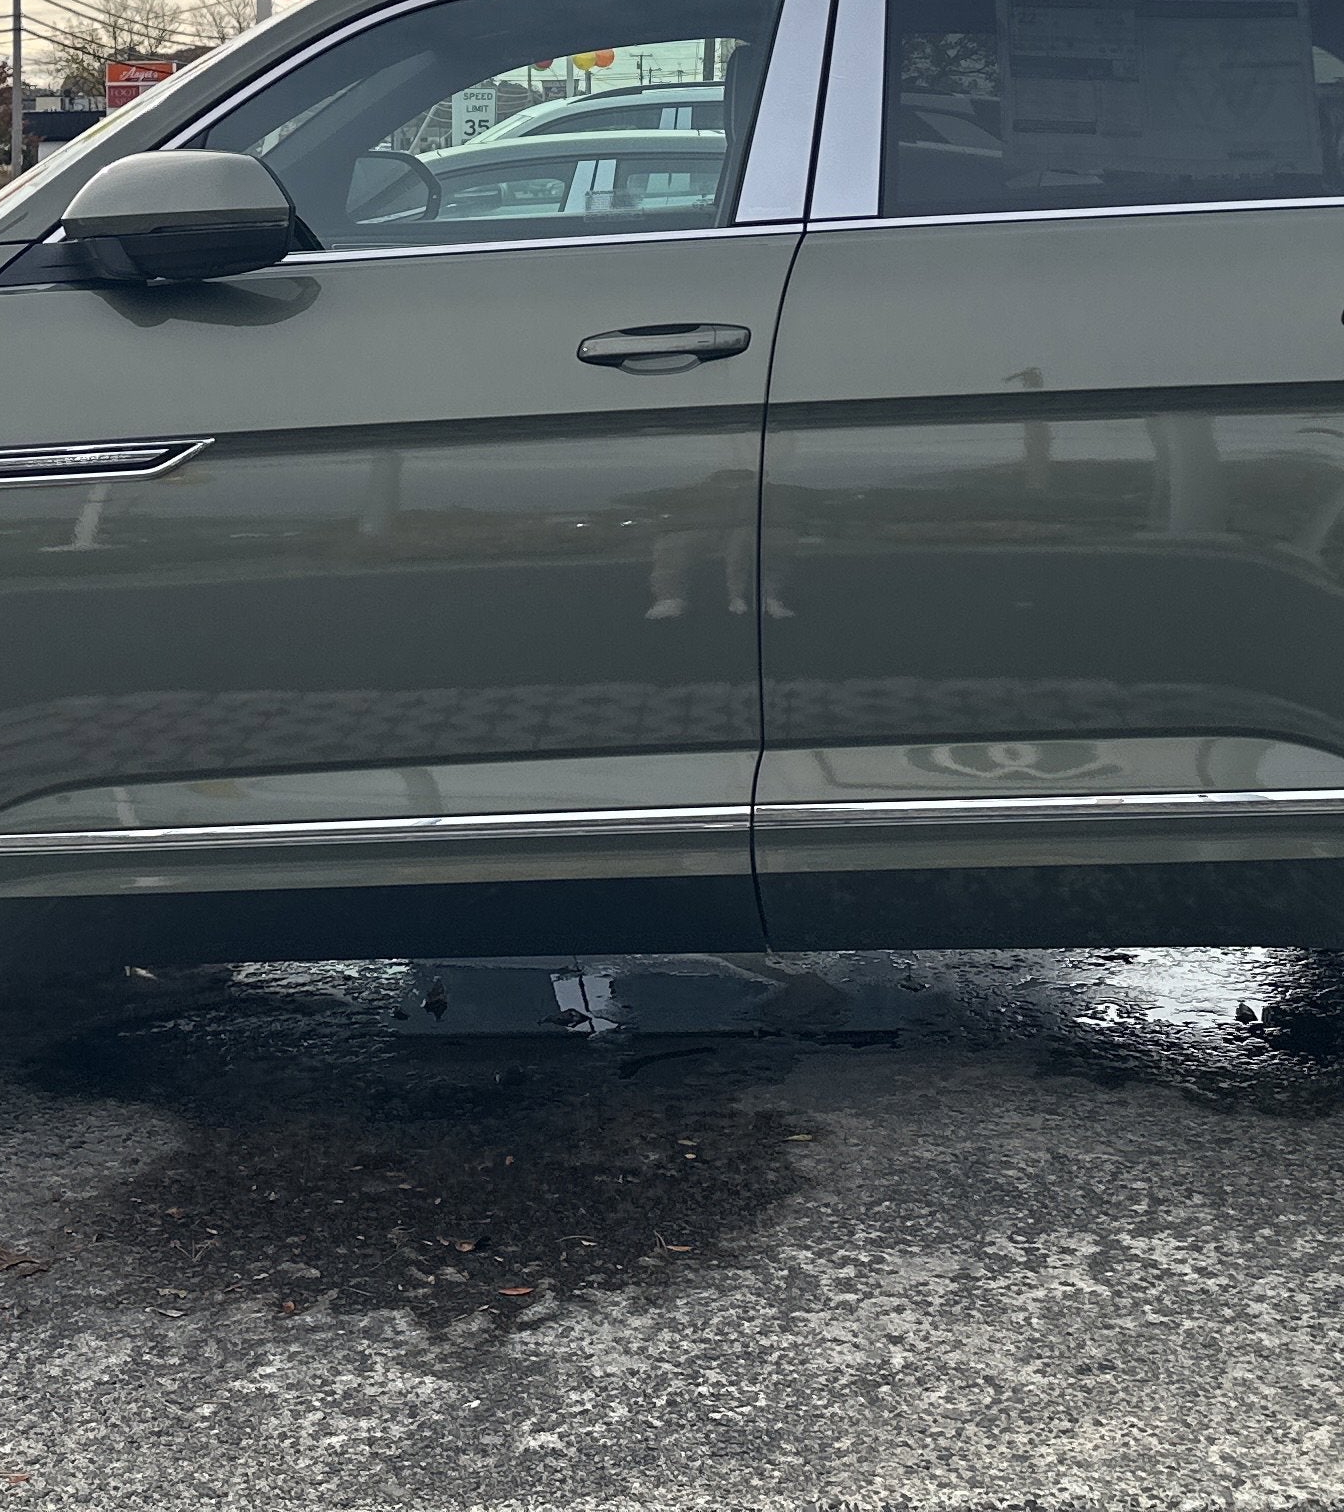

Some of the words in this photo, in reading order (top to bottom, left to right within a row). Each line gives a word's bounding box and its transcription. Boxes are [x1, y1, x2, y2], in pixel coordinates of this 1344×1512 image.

[463, 92, 493, 101] SPEED
[466, 104, 489, 113] LIMIT
[464, 119, 490, 136] 35
